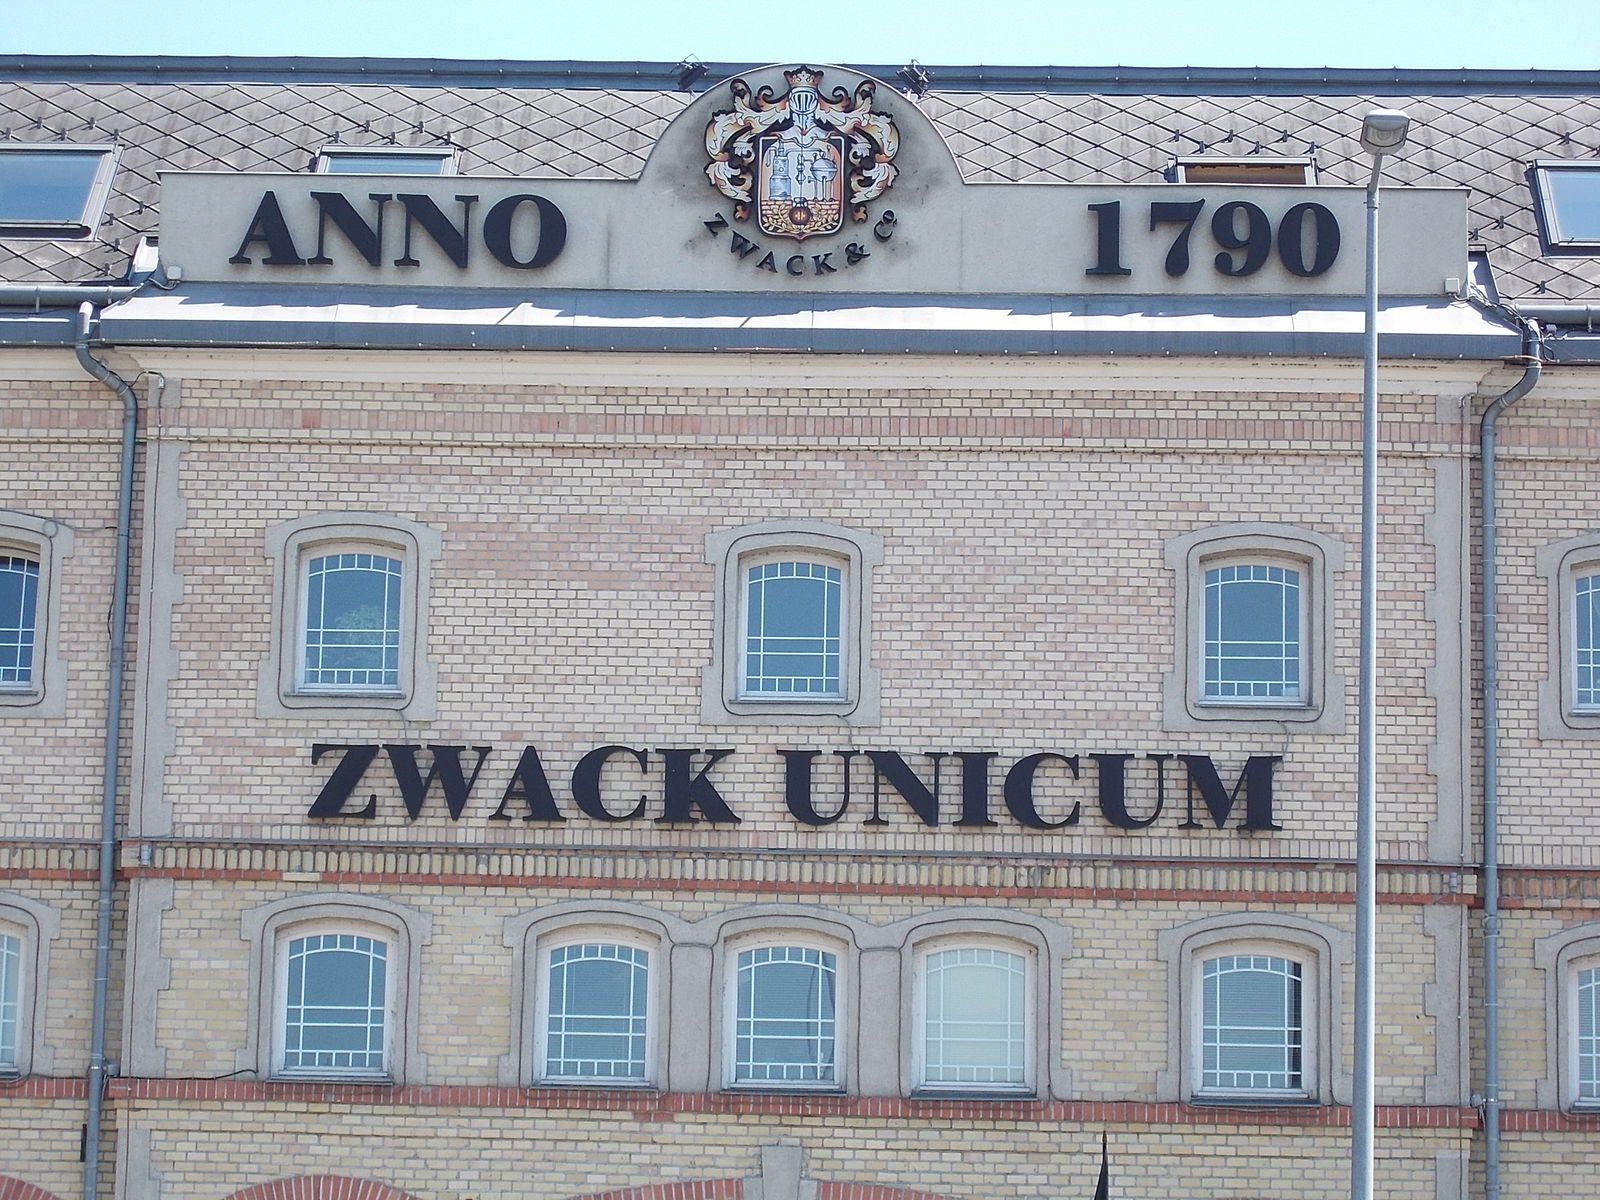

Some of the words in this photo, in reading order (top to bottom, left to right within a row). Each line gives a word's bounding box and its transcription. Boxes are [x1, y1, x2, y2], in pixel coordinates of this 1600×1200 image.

[228, 190, 567, 269] ANNO
[1085, 198, 1341, 277] 1790
[703, 211, 837, 276] ZWACK
[844, 242, 871, 266] &
[307, 743, 742, 825] ZWACK
[776, 749, 1284, 832] UNICUM
